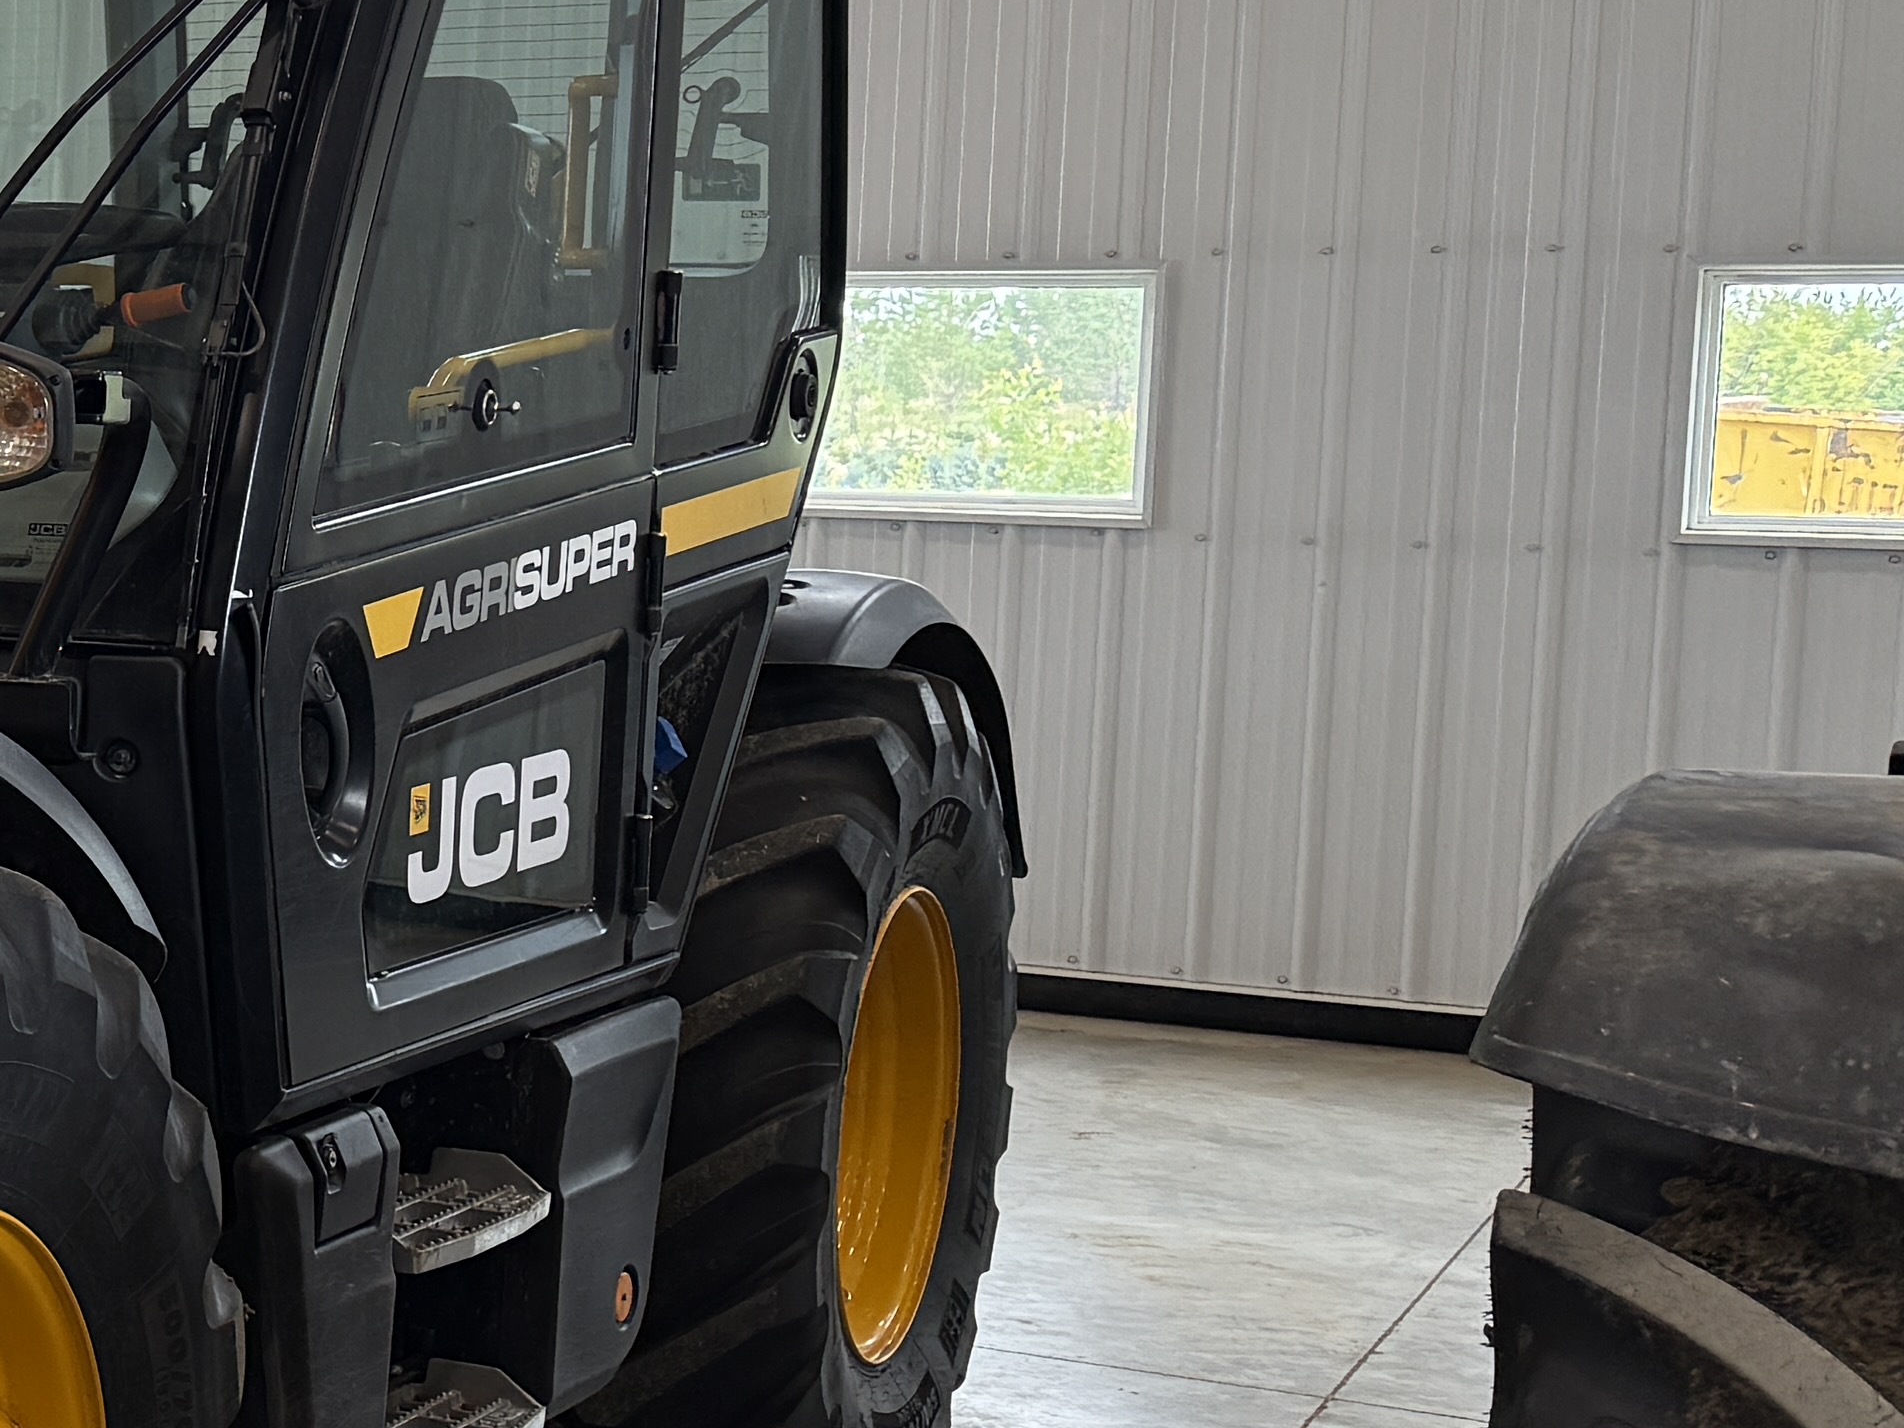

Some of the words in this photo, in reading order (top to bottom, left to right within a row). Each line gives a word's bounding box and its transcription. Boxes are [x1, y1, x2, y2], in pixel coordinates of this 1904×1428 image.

[30, 524, 66, 536] JCB
[420, 519, 638, 643] AGRISUPER
[407, 748, 571, 904] JCB
